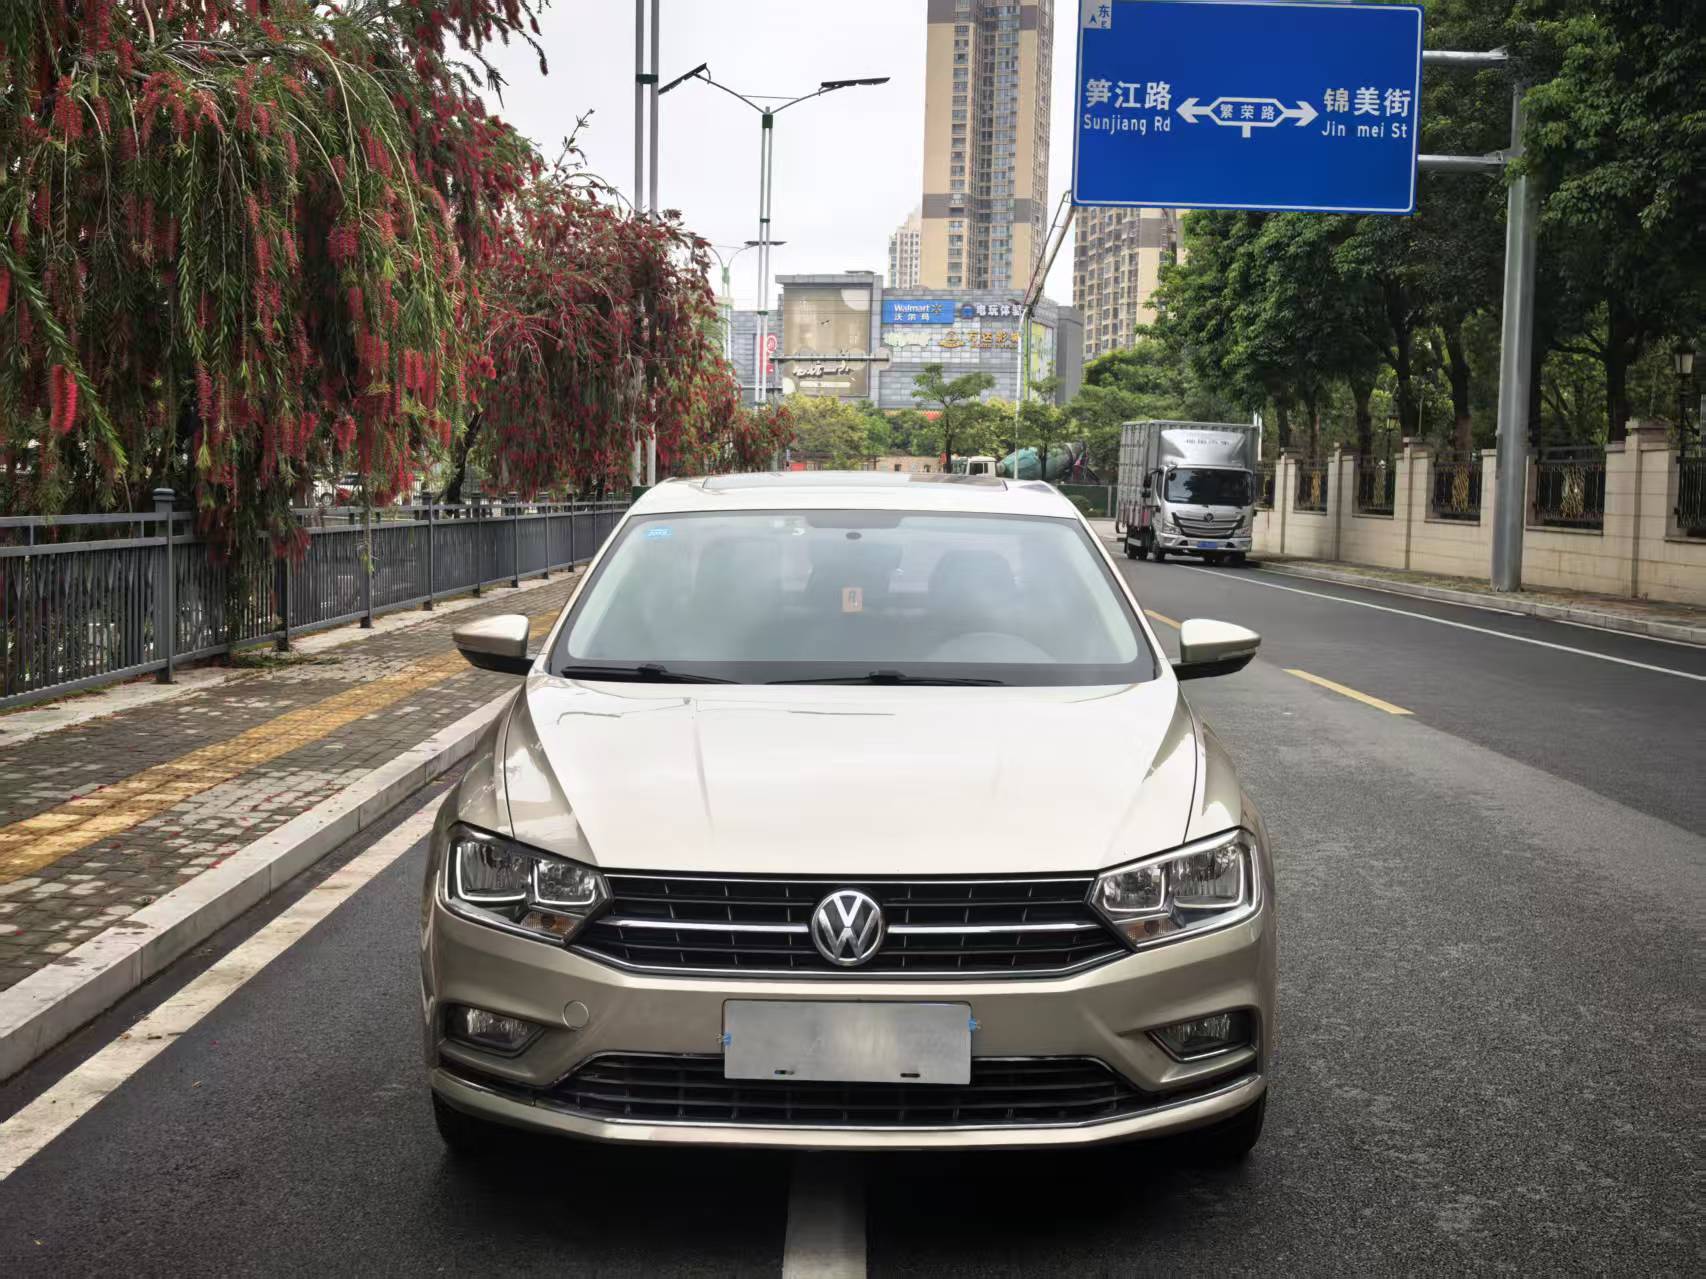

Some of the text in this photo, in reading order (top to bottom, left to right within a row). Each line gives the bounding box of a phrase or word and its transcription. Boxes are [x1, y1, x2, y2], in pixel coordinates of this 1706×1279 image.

[1098, 4, 1110, 18] 东
[1086, 78, 1172, 111] 笋江路
[1323, 86, 1411, 118] 锦美街
[1220, 103, 1276, 121] 繁荣路
[1083, 113, 1171, 135] Sunjiang Rd
[1321, 120, 1408, 138] Jin mei St
[893, 303, 930, 313] Walmart
[894, 312, 930, 321] 沃尔玛
